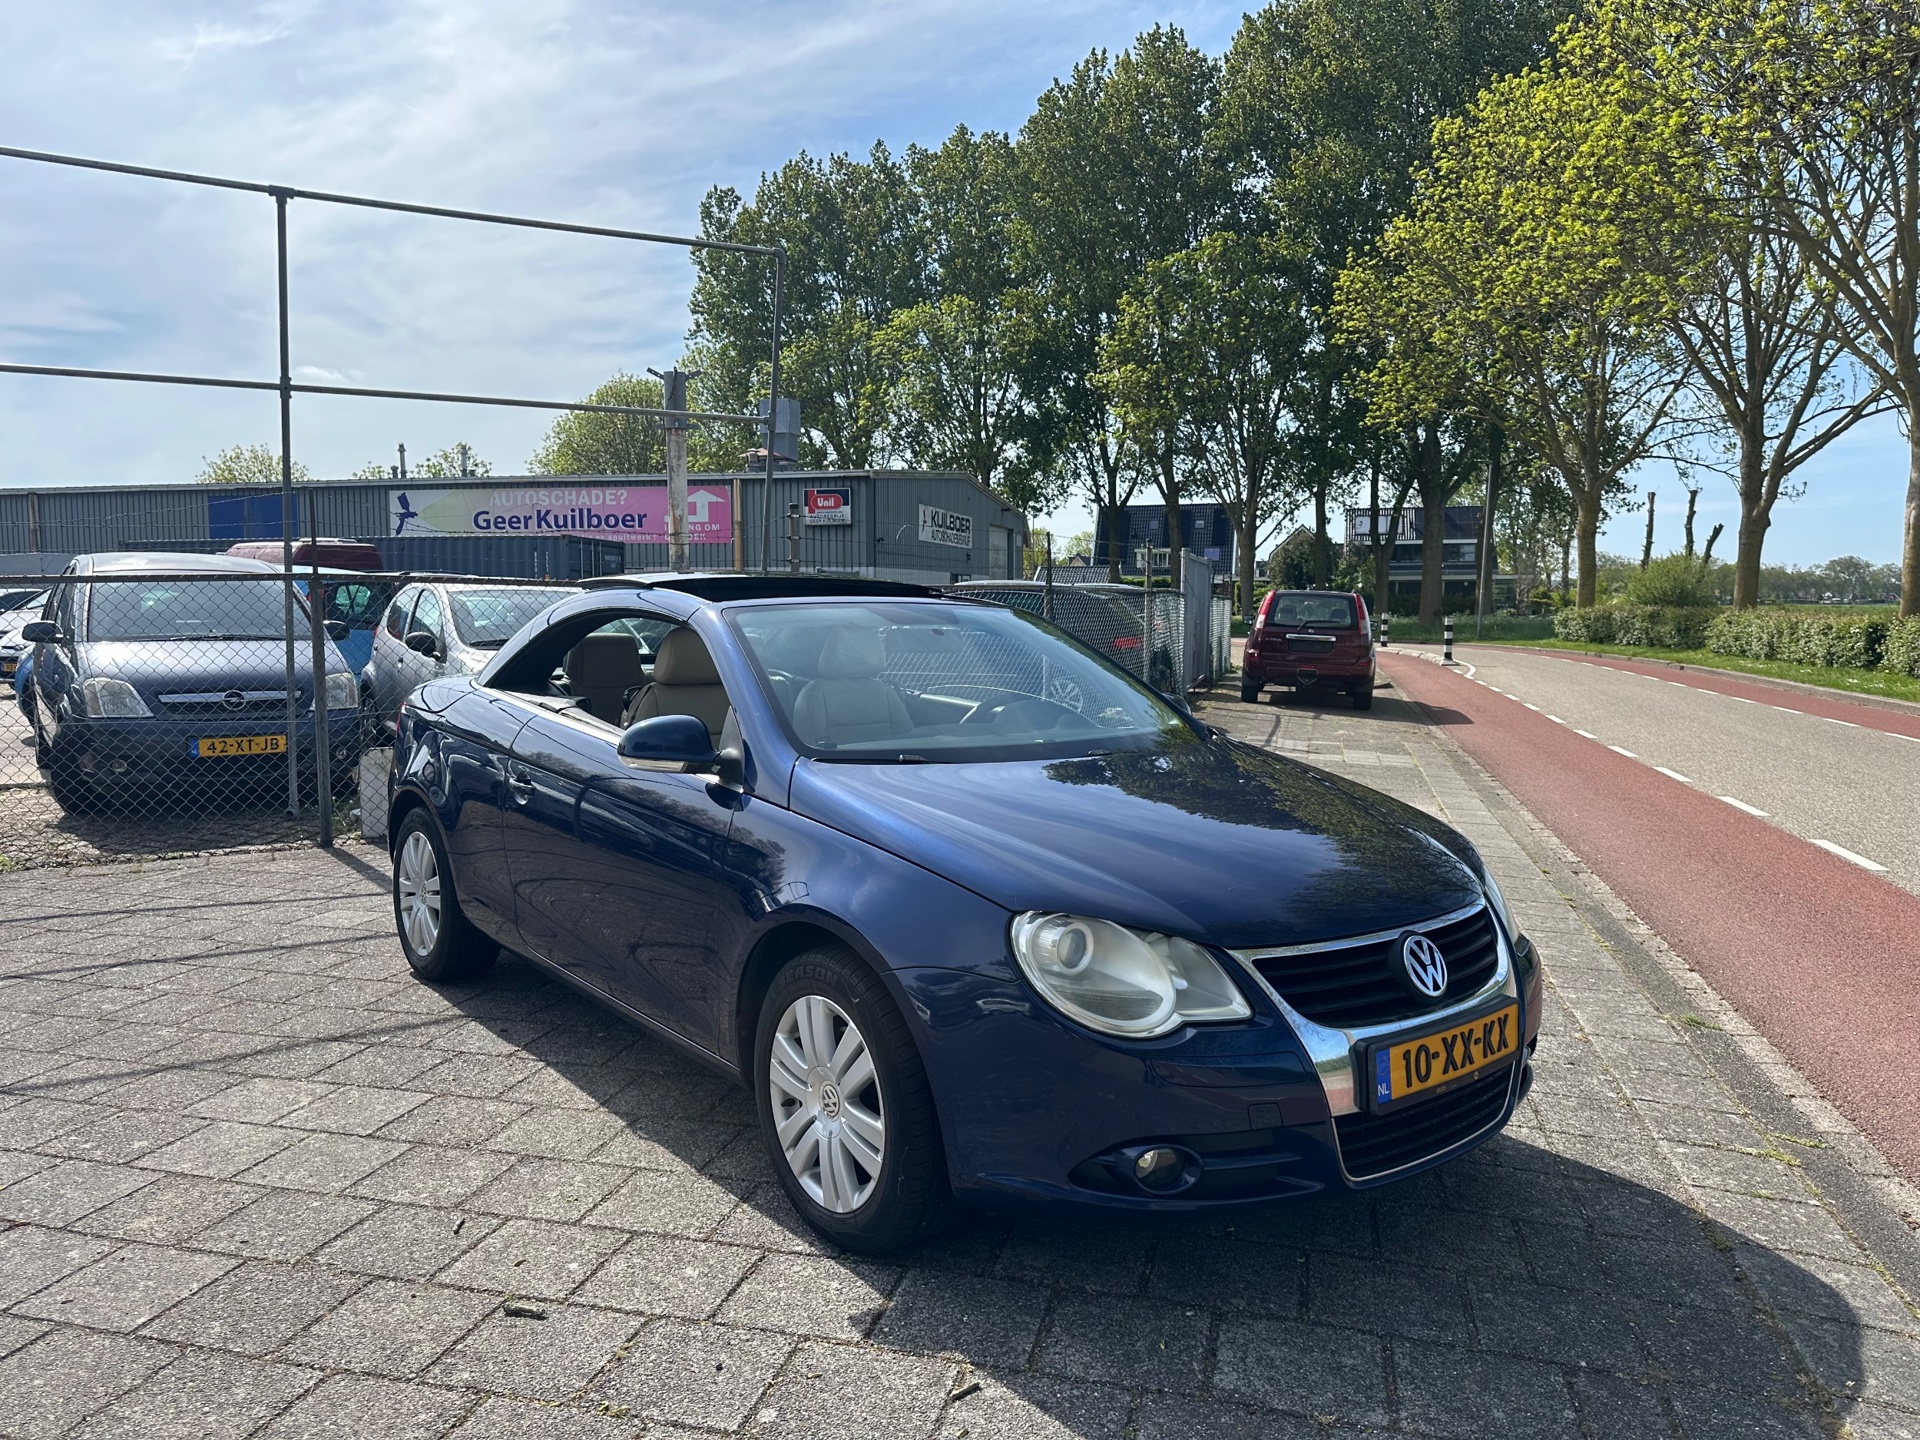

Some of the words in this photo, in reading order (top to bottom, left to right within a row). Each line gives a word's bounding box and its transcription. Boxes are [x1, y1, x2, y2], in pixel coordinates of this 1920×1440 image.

[489, 489, 628, 506] AUTOSCHADE?
[817, 497, 835, 507] Unil
[931, 510, 970, 534] KUILBOER
[206, 737, 279, 754] 42-XT-JB
[1403, 1013, 1509, 1088] 10-XX-KX
[1378, 1083, 1390, 1096] NL
